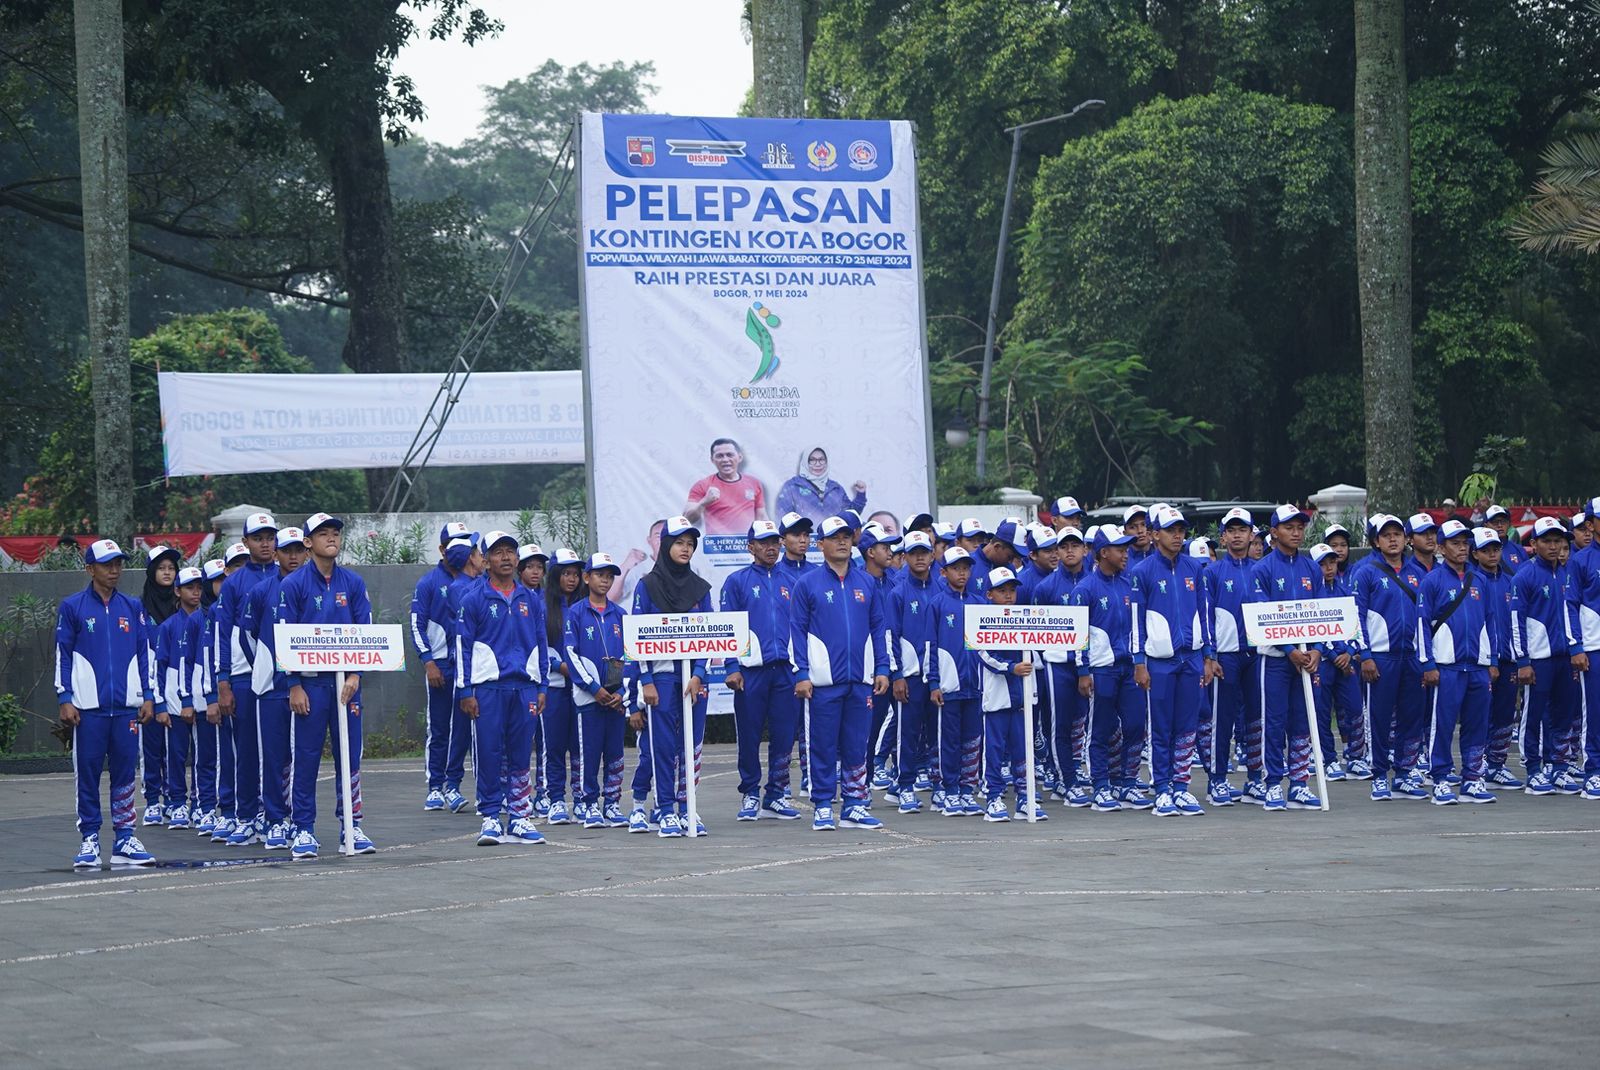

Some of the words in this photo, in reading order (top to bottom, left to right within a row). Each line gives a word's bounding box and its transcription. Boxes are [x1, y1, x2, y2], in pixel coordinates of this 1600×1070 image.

[688, 154, 726, 162] DISPORA
[606, 184, 891, 224] PELEPASAN
[590, 229, 740, 248] KONTINGEN
[748, 230, 816, 249] KOTA
[822, 232, 907, 250] BOGOR
[590, 254, 644, 262] POPWILDA
[646, 254, 692, 263] WILAYAH
[698, 255, 729, 263] JAWA
[729, 255, 760, 263] BARAT
[762, 255, 789, 263] KOTA
[790, 255, 822, 264] DEPOK
[835, 256, 852, 264] S/D
[634, 272, 679, 285] RAIH
[686, 272, 770, 285] PRESTASI
[776, 272, 814, 286] DAN
[819, 272, 876, 286] JUARA
[714, 290, 750, 299] BOGOR,
[731, 386, 800, 399] POPWILDA
[734, 408, 790, 417] WILAYAH
[792, 408, 798, 417] I
[1258, 611, 1298, 621] KONTINGEN
[638, 625, 683, 634] KONTINGEN
[1264, 626, 1306, 639] SEPAK
[1308, 624, 1344, 636] BOLA
[976, 632, 1018, 644] SEPAK
[1020, 632, 1077, 644] TAKRAW
[636, 641, 676, 654] TENIS
[680, 640, 738, 652] LAPANG
[298, 652, 340, 664] TENIS
[344, 652, 383, 664] MEJA
